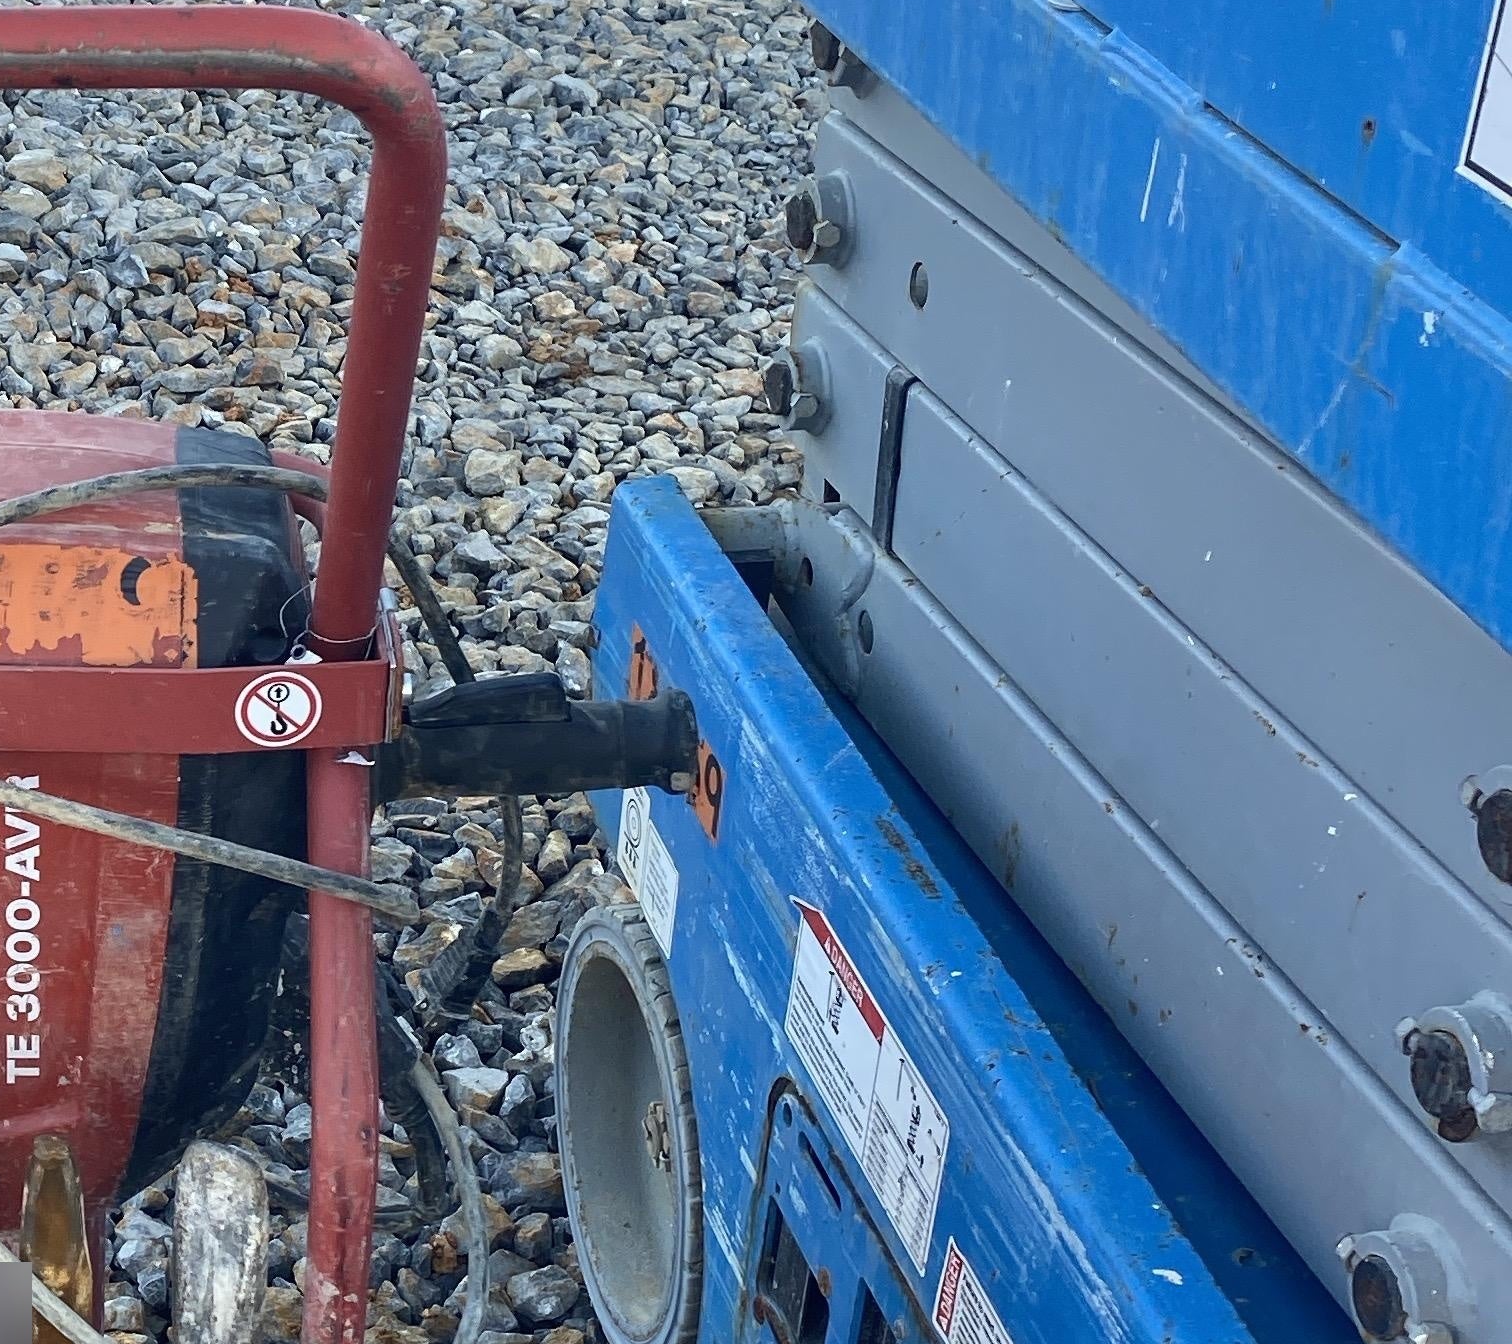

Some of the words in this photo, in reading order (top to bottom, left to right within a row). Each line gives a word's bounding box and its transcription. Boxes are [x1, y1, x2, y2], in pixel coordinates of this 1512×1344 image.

[828, 945, 864, 1008] DANGER
[5, 1029, 40, 1085] TE
[943, 1257, 962, 1316] DANGER
